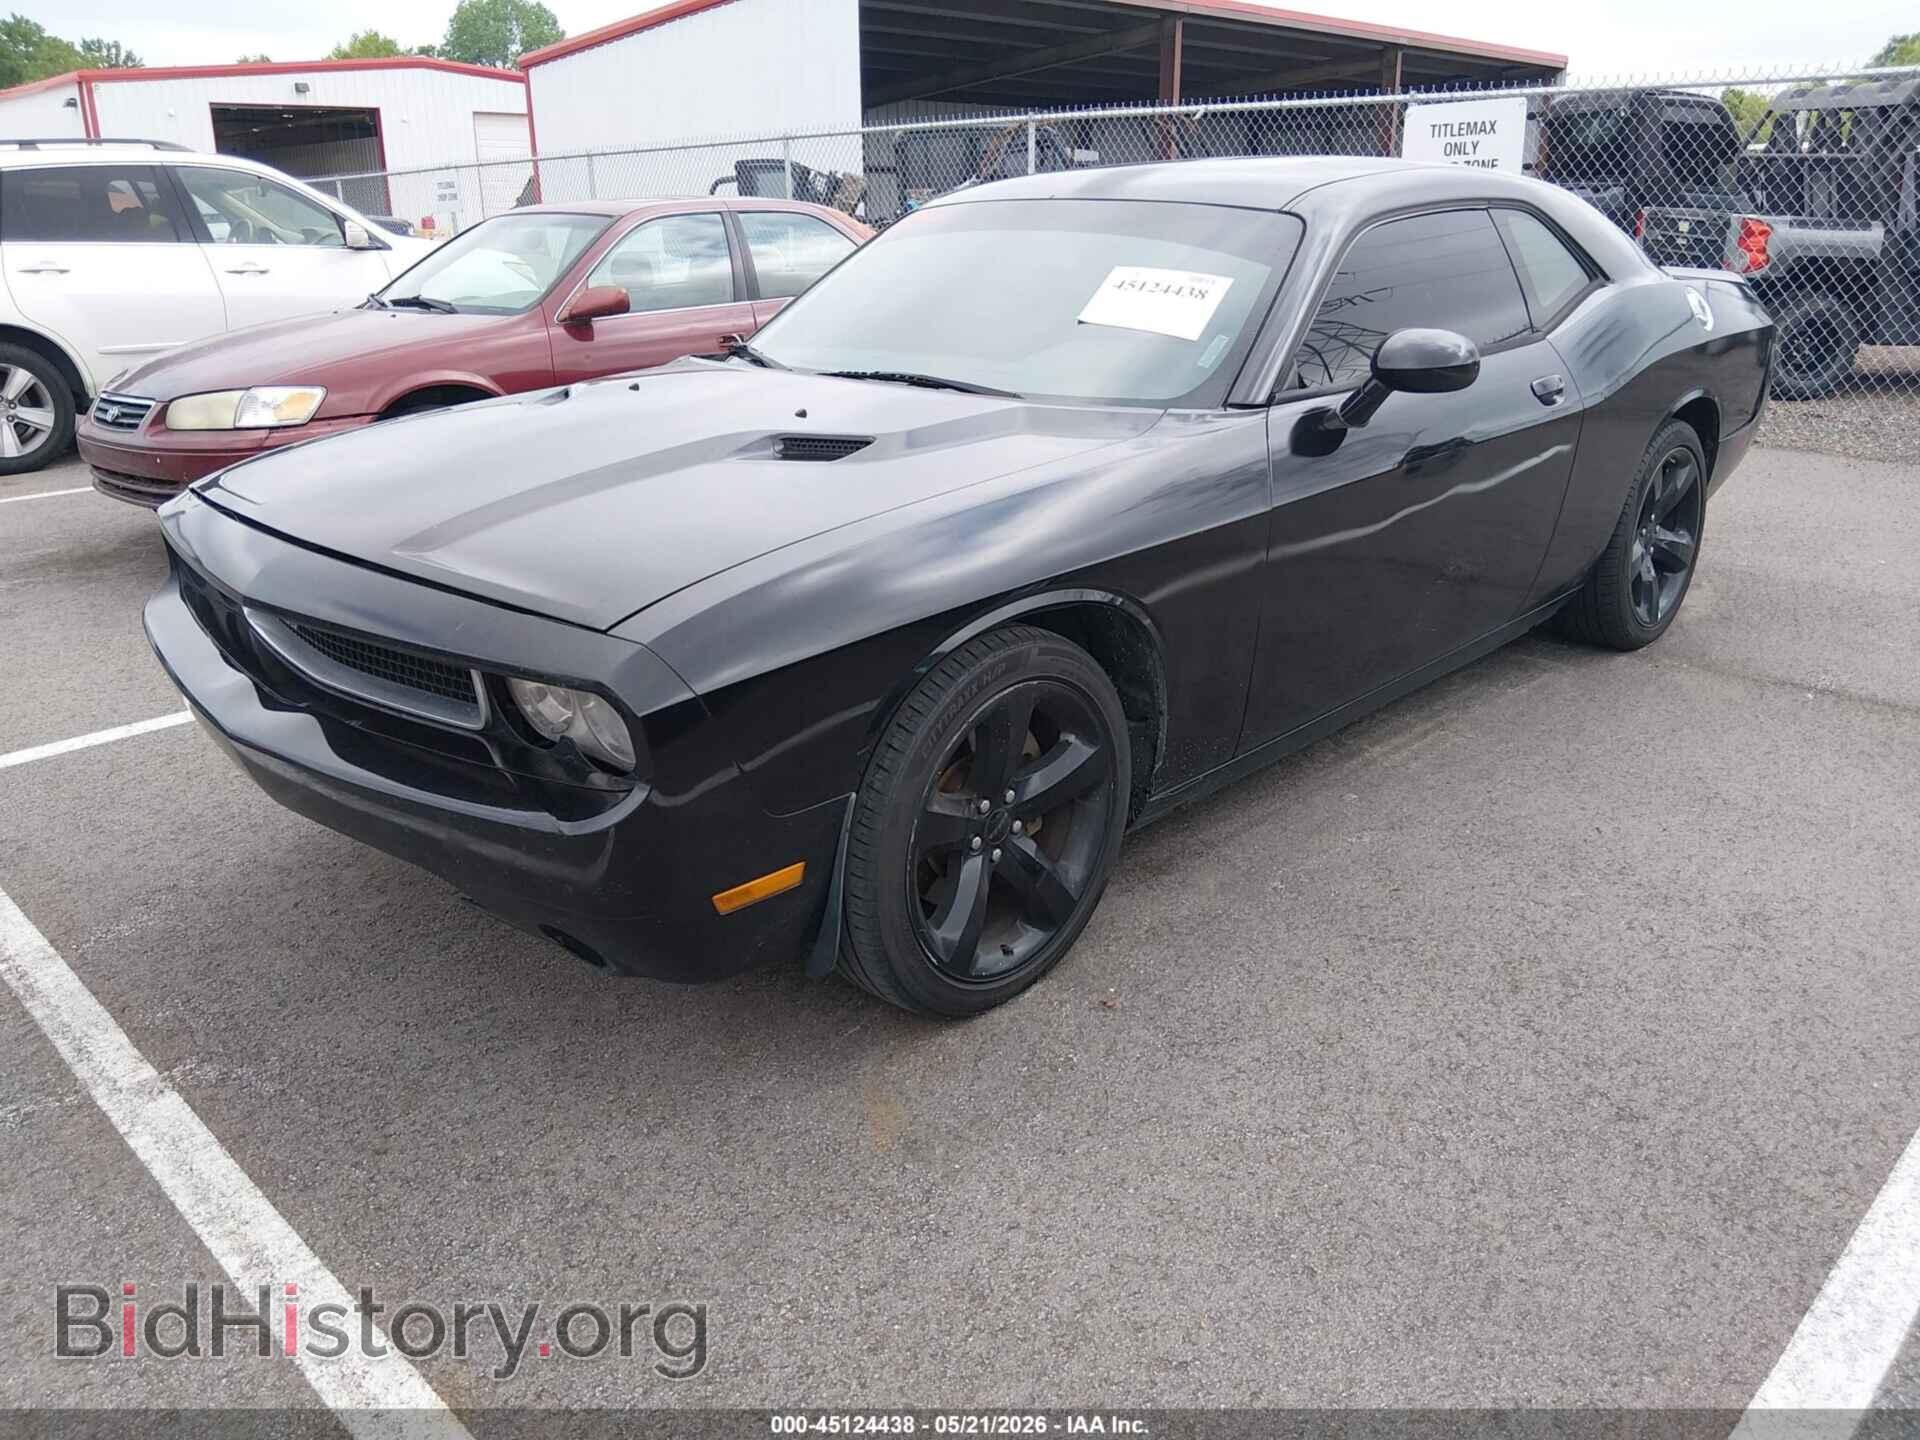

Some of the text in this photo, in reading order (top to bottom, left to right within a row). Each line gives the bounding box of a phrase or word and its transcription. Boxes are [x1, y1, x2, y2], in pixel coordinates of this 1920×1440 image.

[1430, 120, 1497, 138] TITLEMAX
[1443, 140, 1480, 156] ONLY
[1112, 279, 1209, 299] 45124438
